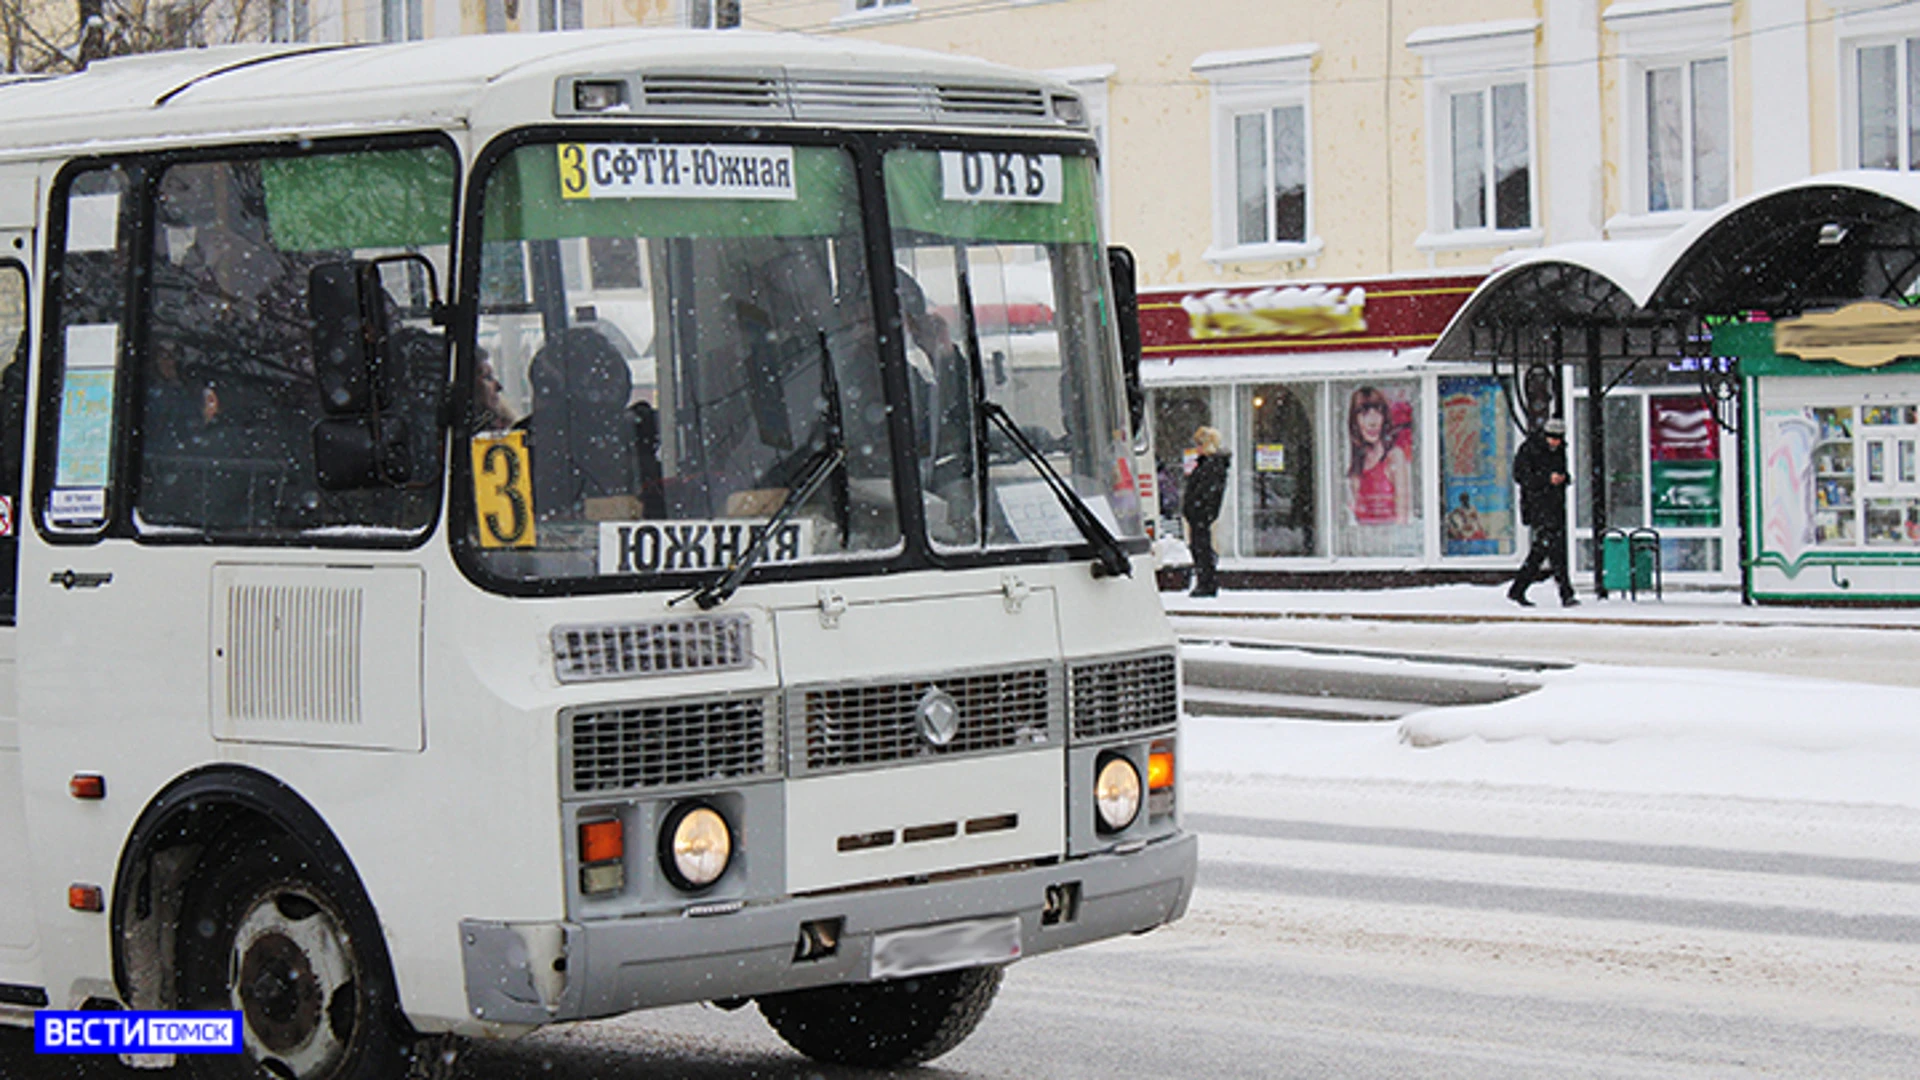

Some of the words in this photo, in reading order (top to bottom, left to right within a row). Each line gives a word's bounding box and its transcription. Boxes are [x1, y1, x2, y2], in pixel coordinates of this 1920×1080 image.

[563, 145, 587, 193] 3
[591, 148, 791, 188] СФТИ-Южная
[483, 444, 528, 543] 3
